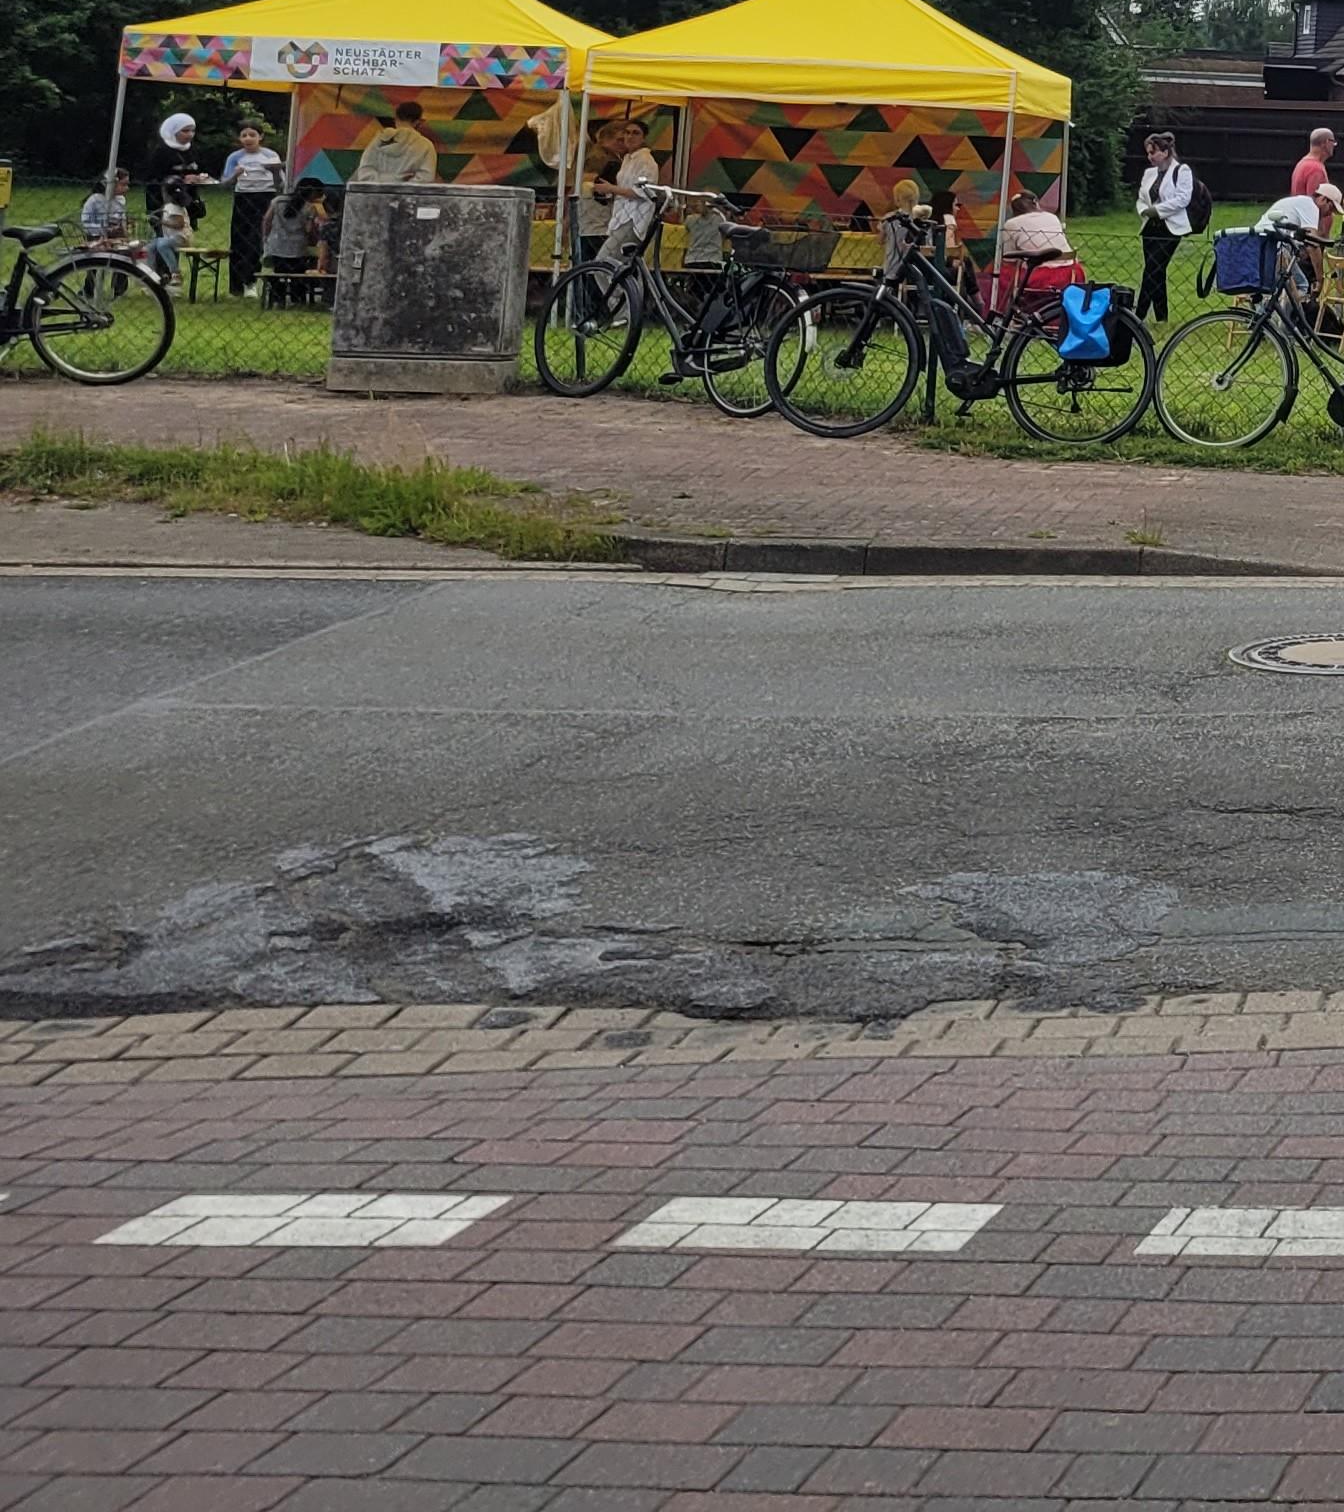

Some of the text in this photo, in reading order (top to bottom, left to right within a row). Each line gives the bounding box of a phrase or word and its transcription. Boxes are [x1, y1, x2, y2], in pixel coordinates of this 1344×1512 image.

[335, 46, 422, 60] NEUSTÄDTER
[334, 57, 405, 68] NACHBAR-
[333, 66, 386, 77] SCHATZ
